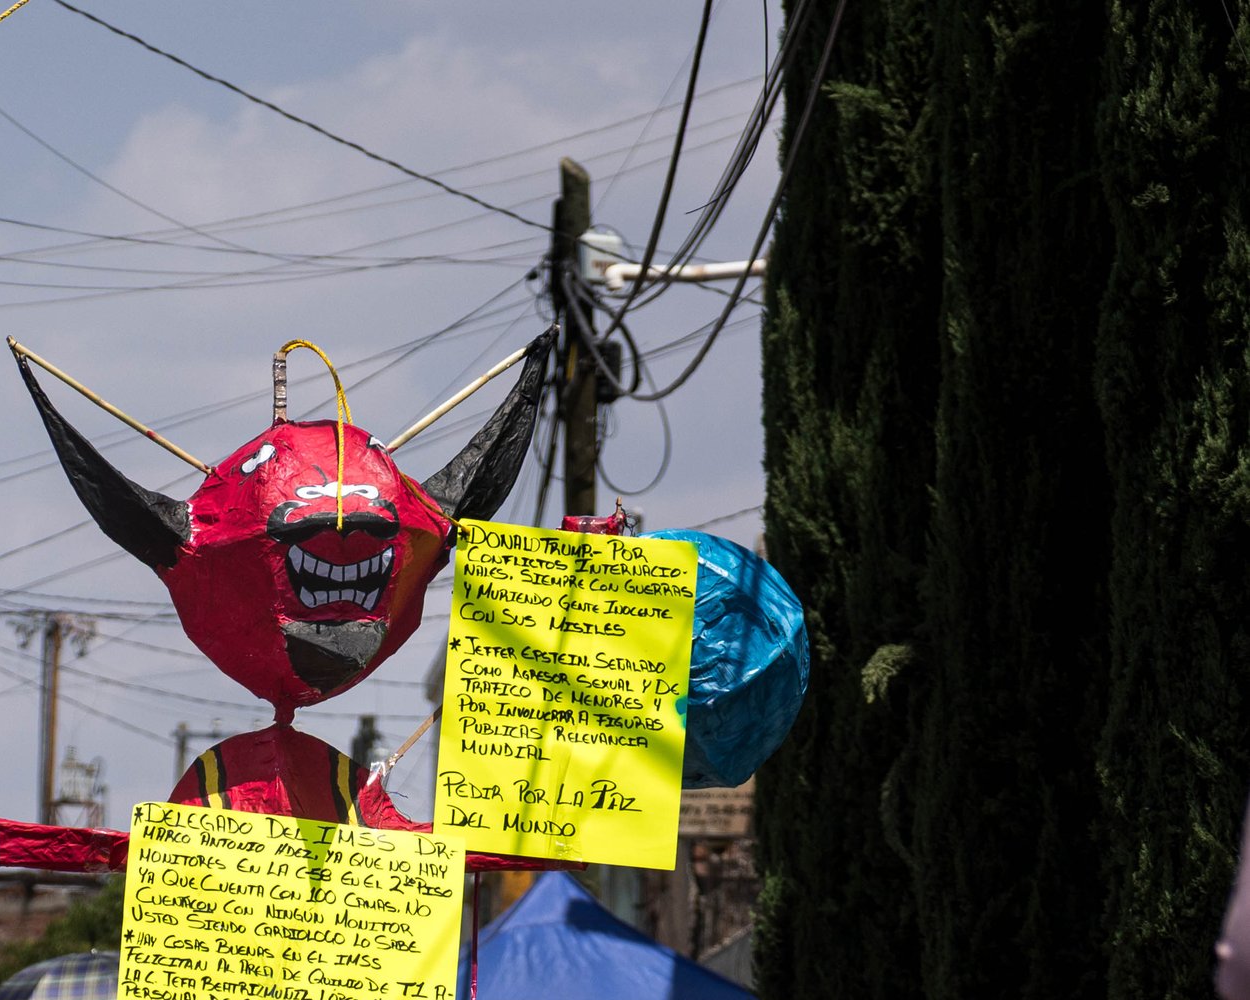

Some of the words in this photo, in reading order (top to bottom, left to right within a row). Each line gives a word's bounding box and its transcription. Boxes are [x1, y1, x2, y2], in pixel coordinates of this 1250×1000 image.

[466, 525, 540, 552] DONALD
[607, 539, 648, 562] POR
[468, 547, 567, 570] CONFLICTOS
[464, 582, 471, 598] Y
[478, 583, 552, 606] MURIENDO
[559, 595, 599, 613] GENTE
[603, 601, 672, 619] INOCENTE
[522, 569, 584, 589] SIEMPRE
[590, 579, 618, 592] CON
[625, 579, 693, 597] GUERRAS
[460, 603, 494, 623] CON
[501, 609, 536, 627] SUS
[550, 617, 625, 636] MISILES
[464, 637, 515, 659] JEFFER
[460, 659, 502, 677] COMO
[513, 668, 570, 685] AGRESOR
[577, 675, 633, 691] SEXUAL
[643, 680, 651, 692] Y
[655, 679, 679, 696] DE
[461, 678, 531, 697] TRAFICO
[543, 687, 563, 703] DE
[572, 692, 643, 710] MENORES
[654, 698, 661, 711] Y
[457, 694, 490, 715] POR
[579, 711, 588, 724] A
[593, 713, 663, 731] FIGURAS
[459, 716, 542, 739] PUBLICAS
[554, 726, 647, 748] RELEVANCIA
[461, 740, 550, 761] MUNDIAL
[440, 771, 503, 801] PEDIR
[513, 780, 549, 805] POR
[556, 783, 583, 807] LA
[591, 780, 642, 811] PAZ
[144, 803, 251, 834] DELEGADO
[266, 817, 309, 841] DEL
[312, 826, 395, 851] IMSS
[443, 805, 490, 828] DEL
[503, 813, 575, 836] MUNDO
[143, 827, 191, 844] MARCO
[201, 832, 265, 852] ANTONIO
[325, 850, 342, 863] YA
[349, 852, 383, 870] QUE
[388, 859, 411, 873] NO
[419, 864, 447, 878] HAY
[140, 848, 226, 870] MONITORES
[237, 859, 261, 874] EN
[267, 861, 288, 877] LA
[341, 872, 360, 886] EN
[363, 877, 382, 890] EL
[415, 881, 453, 898] PISO
[139, 867, 154, 884] YA
[162, 869, 198, 890] QUE
[200, 875, 264, 897] CUENTA
[269, 884, 301, 901] CON
[307, 887, 336, 904] 100
[405, 899, 431, 917] NO
[132, 906, 178, 926] USTED
[186, 914, 247, 933] SIENDO
[354, 933, 370, 948] LO
[375, 936, 421, 953] SABE
[223, 899, 253, 915] CON
[335, 912, 413, 936] MONITOR
[137, 931, 156, 947] HAY
[163, 935, 209, 952] COSAS
[216, 939, 275, 958] BUENAS
[282, 947, 301, 961] EN
[307, 949, 328, 963] EL
[334, 954, 381, 969] IMSS
[124, 968, 144, 981] LA
[163, 972, 195, 989] JEFA
[217, 958, 235, 973] AL
[240, 960, 273, 978] AREA
[282, 967, 301, 981] DE
[368, 976, 391, 992] DE
